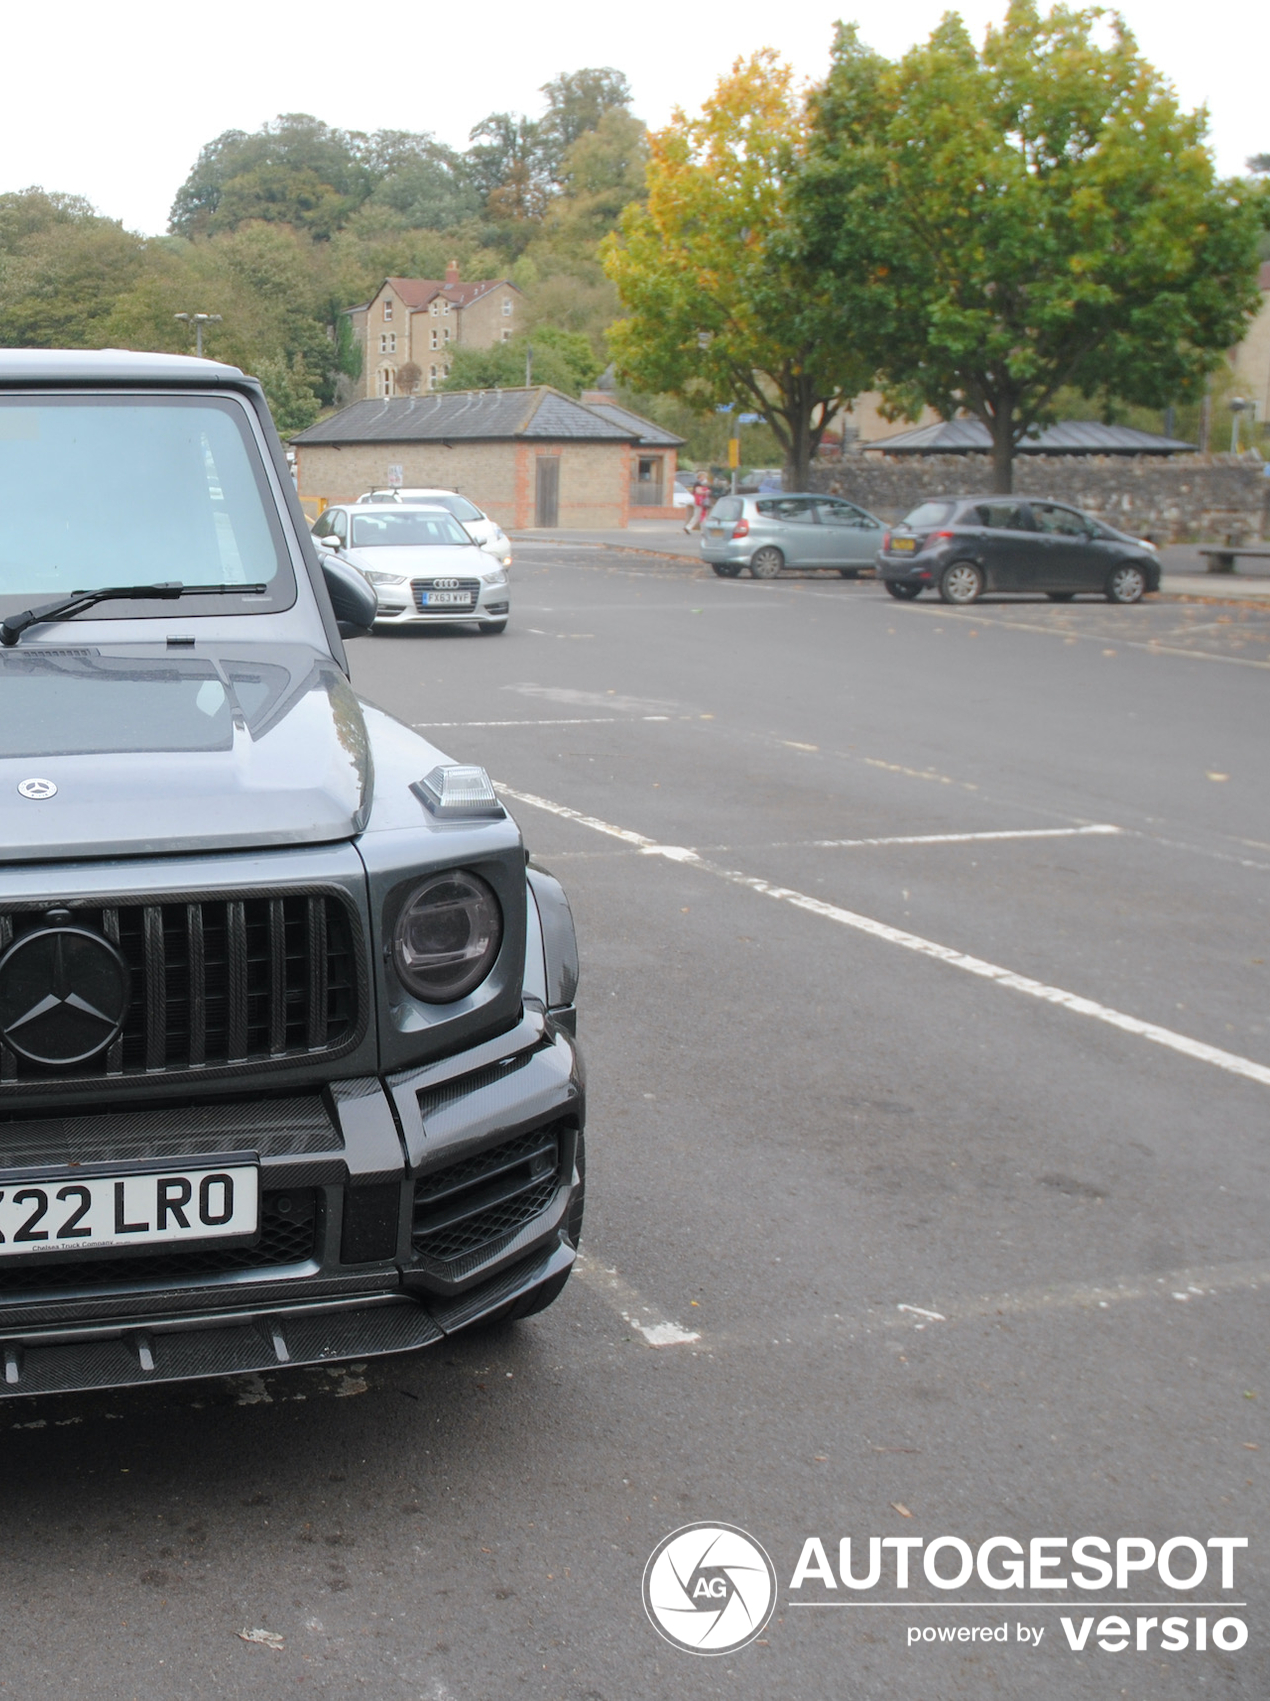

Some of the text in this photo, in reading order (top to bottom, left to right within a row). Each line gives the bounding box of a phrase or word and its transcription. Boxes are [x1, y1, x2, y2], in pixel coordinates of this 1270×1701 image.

[114, 1173, 234, 1234] LRO
[32, 1244, 60, 1252] Chelsea
[61, 1242, 80, 1250] Truck
[82, 1240, 114, 1248] Company
